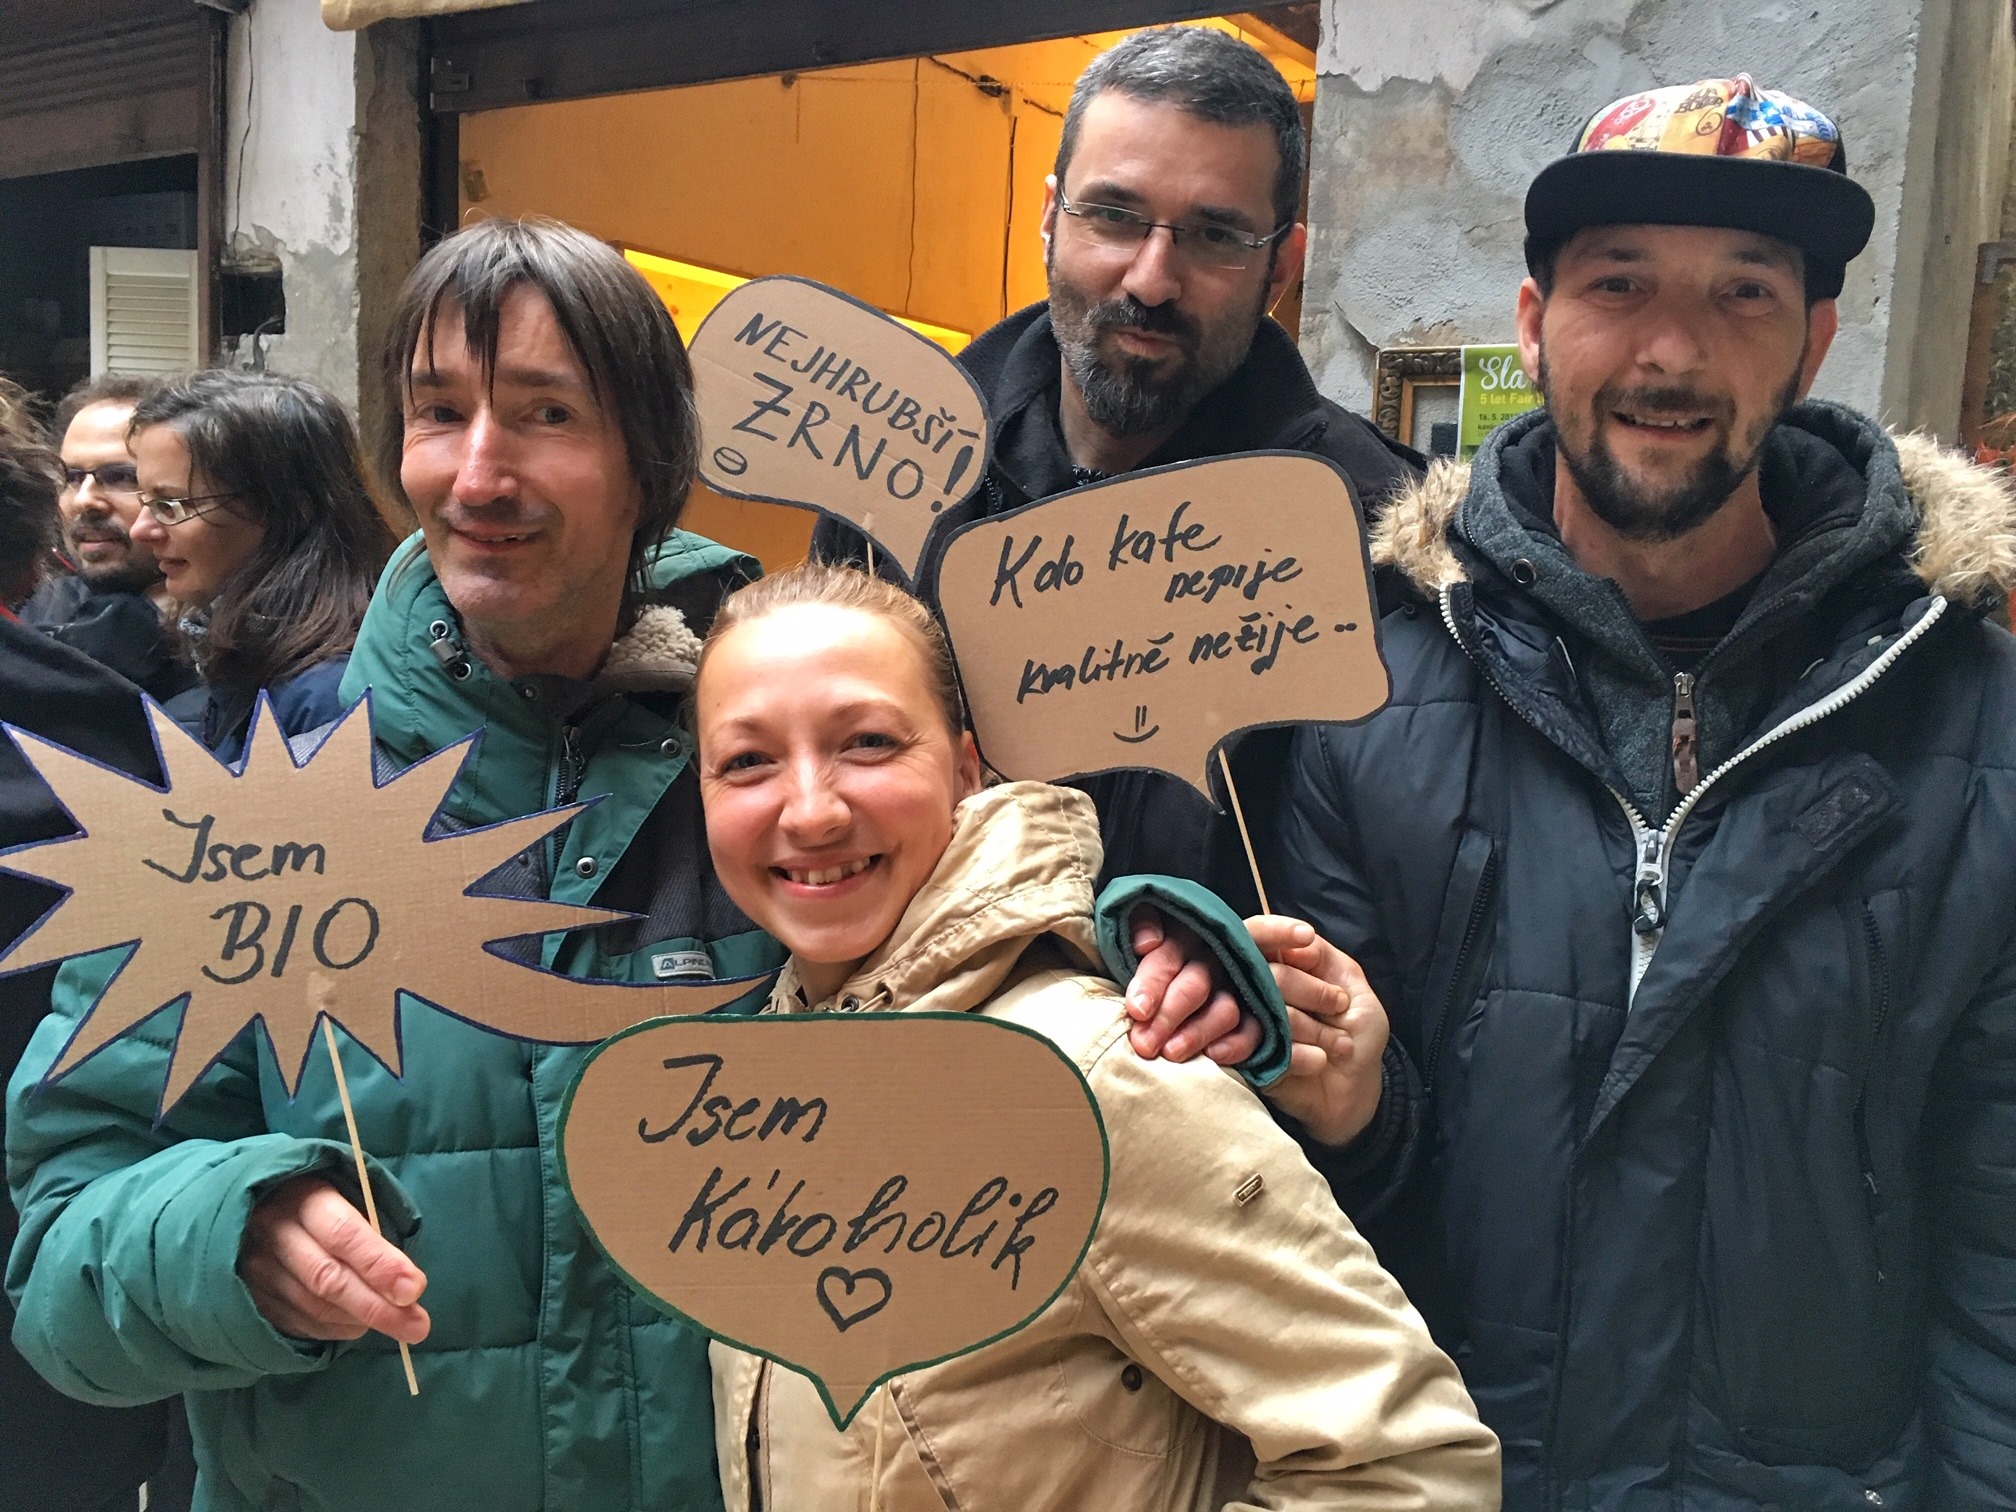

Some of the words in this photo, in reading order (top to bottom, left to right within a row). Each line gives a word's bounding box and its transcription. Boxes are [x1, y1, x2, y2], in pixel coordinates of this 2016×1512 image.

[734, 312, 980, 454] NEJHRUBŠÍ
[1479, 354, 1528, 390] Sla
[1480, 394, 1487, 405] 5
[1490, 394, 1506, 404] let
[1510, 392, 1533, 404] Fair
[990, 535, 1084, 608] Kdo
[1108, 501, 1222, 571] kafe
[1164, 548, 1303, 602] nepije
[141, 808, 326, 883] Jsem
[201, 897, 380, 985] BIO
[638, 1054, 828, 1147] Jsem
